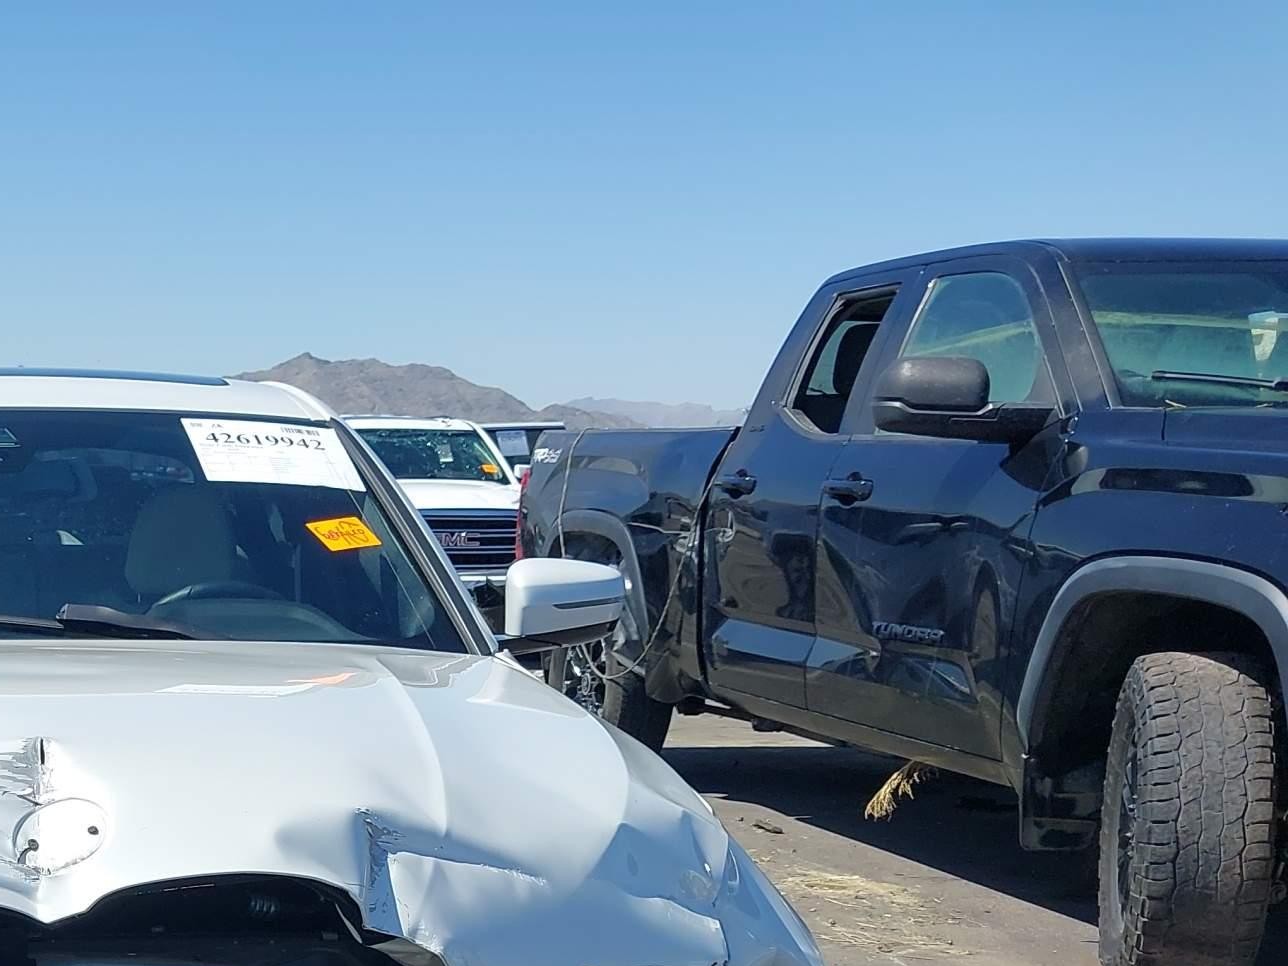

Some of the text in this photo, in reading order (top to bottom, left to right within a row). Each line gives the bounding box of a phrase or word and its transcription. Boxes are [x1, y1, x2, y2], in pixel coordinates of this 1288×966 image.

[205, 432, 321, 451] 42619942
[435, 532, 480, 547] MC
[871, 621, 945, 640] TUNDRA
